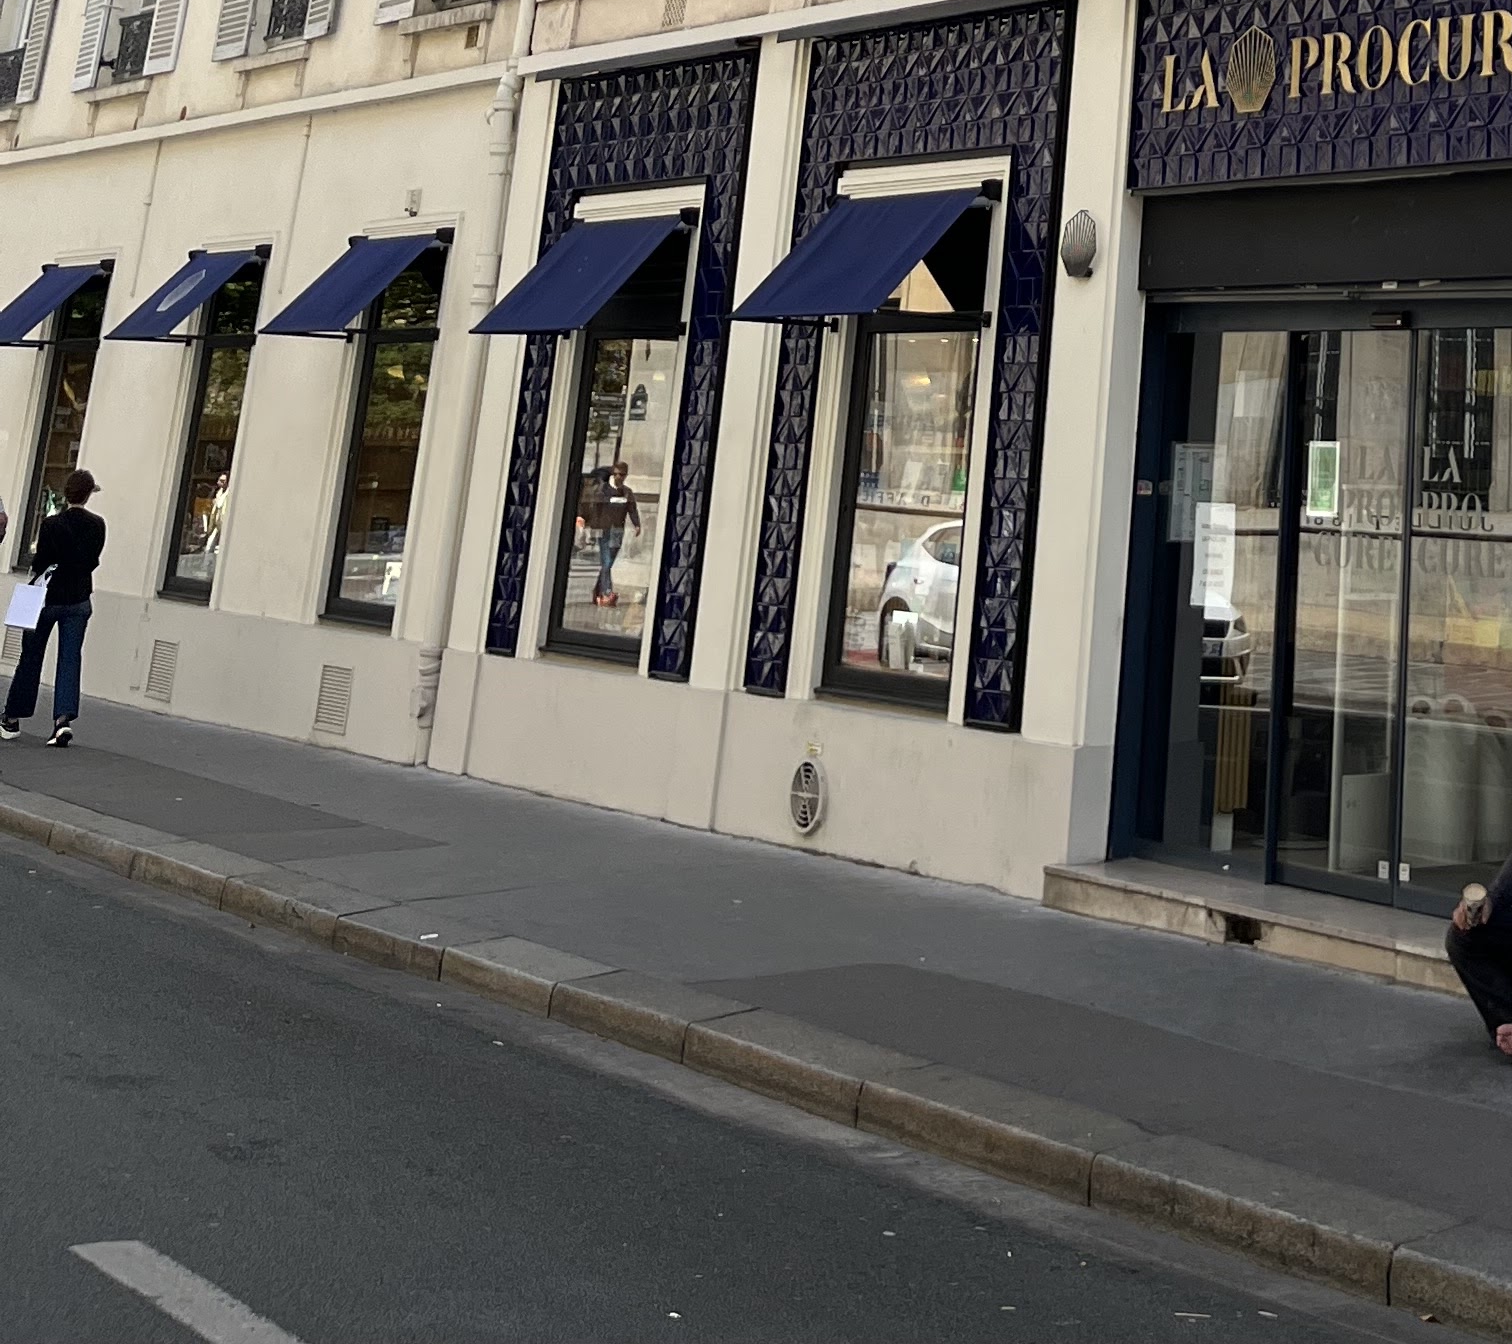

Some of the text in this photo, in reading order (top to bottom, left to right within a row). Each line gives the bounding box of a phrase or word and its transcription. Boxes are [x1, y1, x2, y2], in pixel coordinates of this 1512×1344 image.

[1160, 48, 1221, 113] LA
[1357, 445, 1398, 481] LA
[1421, 445, 1463, 483] LA
[1421, 491, 1483, 530] PRO
[1416, 536, 1506, 579] CURE
